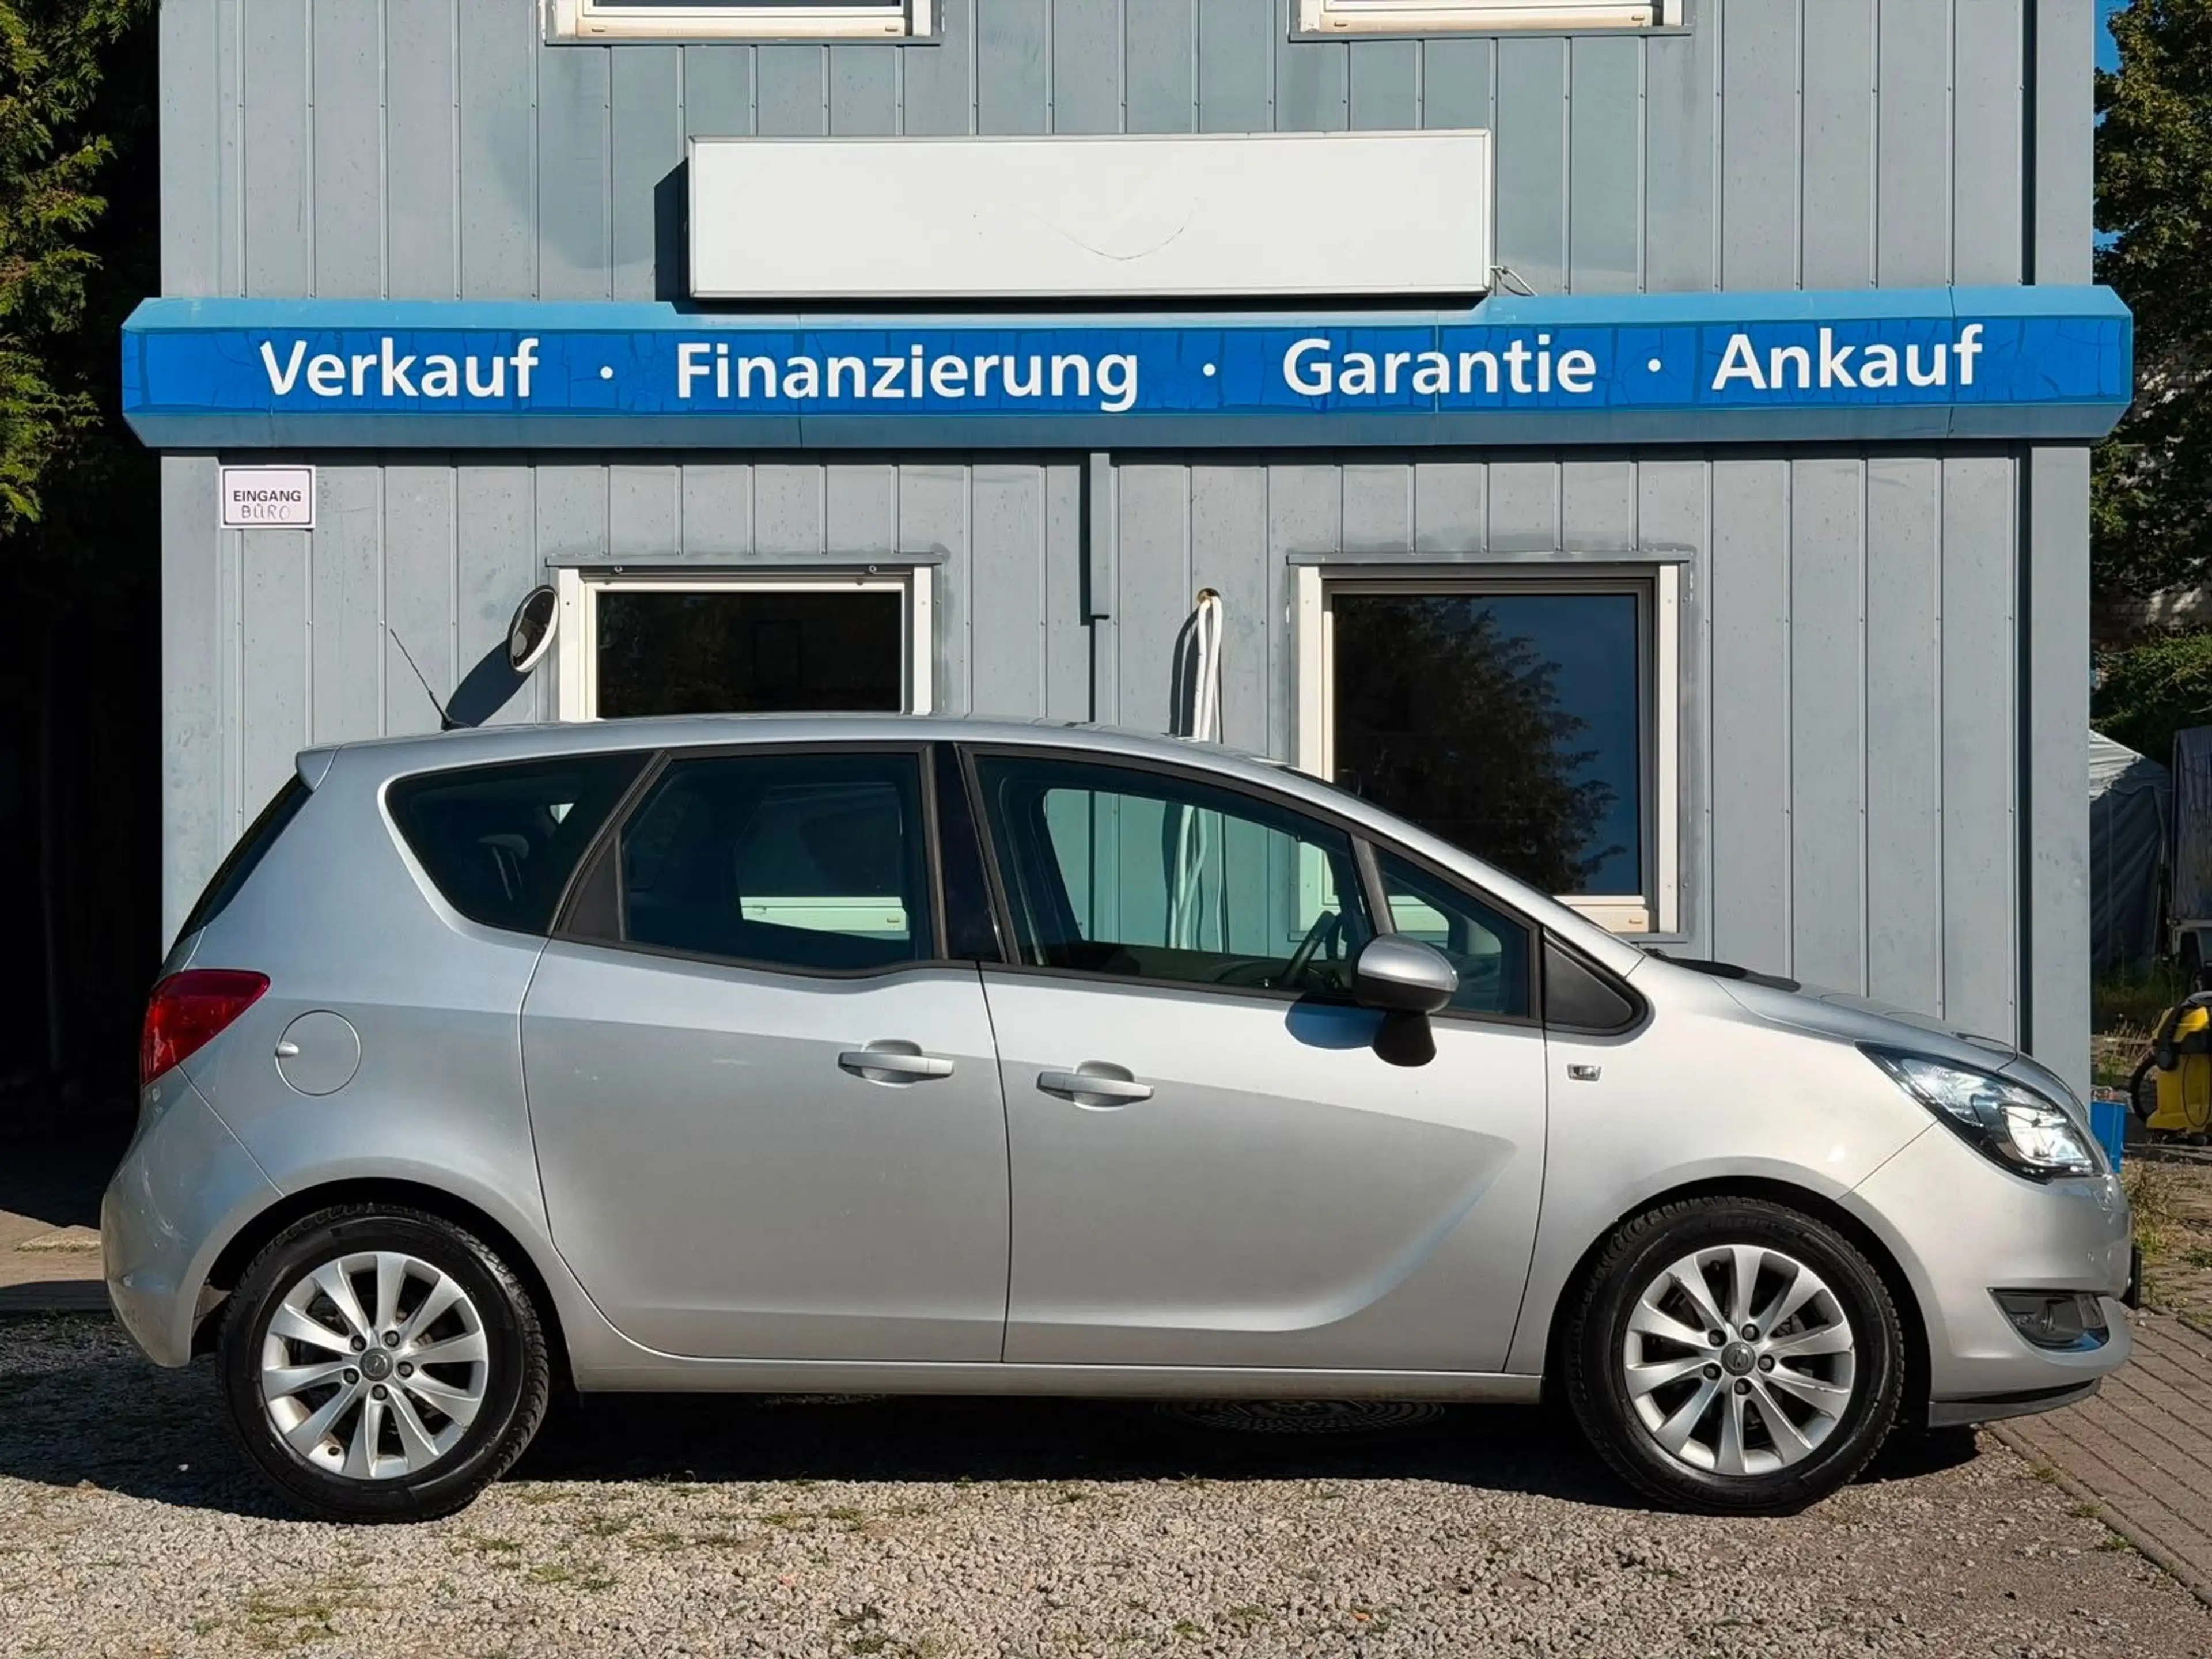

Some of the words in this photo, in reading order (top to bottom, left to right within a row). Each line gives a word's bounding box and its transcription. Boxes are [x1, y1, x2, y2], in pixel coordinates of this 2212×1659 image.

[261, 338, 539, 397] Verkauf
[679, 343, 1137, 412] Finanzierung
[1283, 334, 1596, 395] Garantie
[1712, 324, 1983, 390] Ankauf
[233, 490, 301, 502] EINGANG
[241, 503, 290, 520] BÜRO
